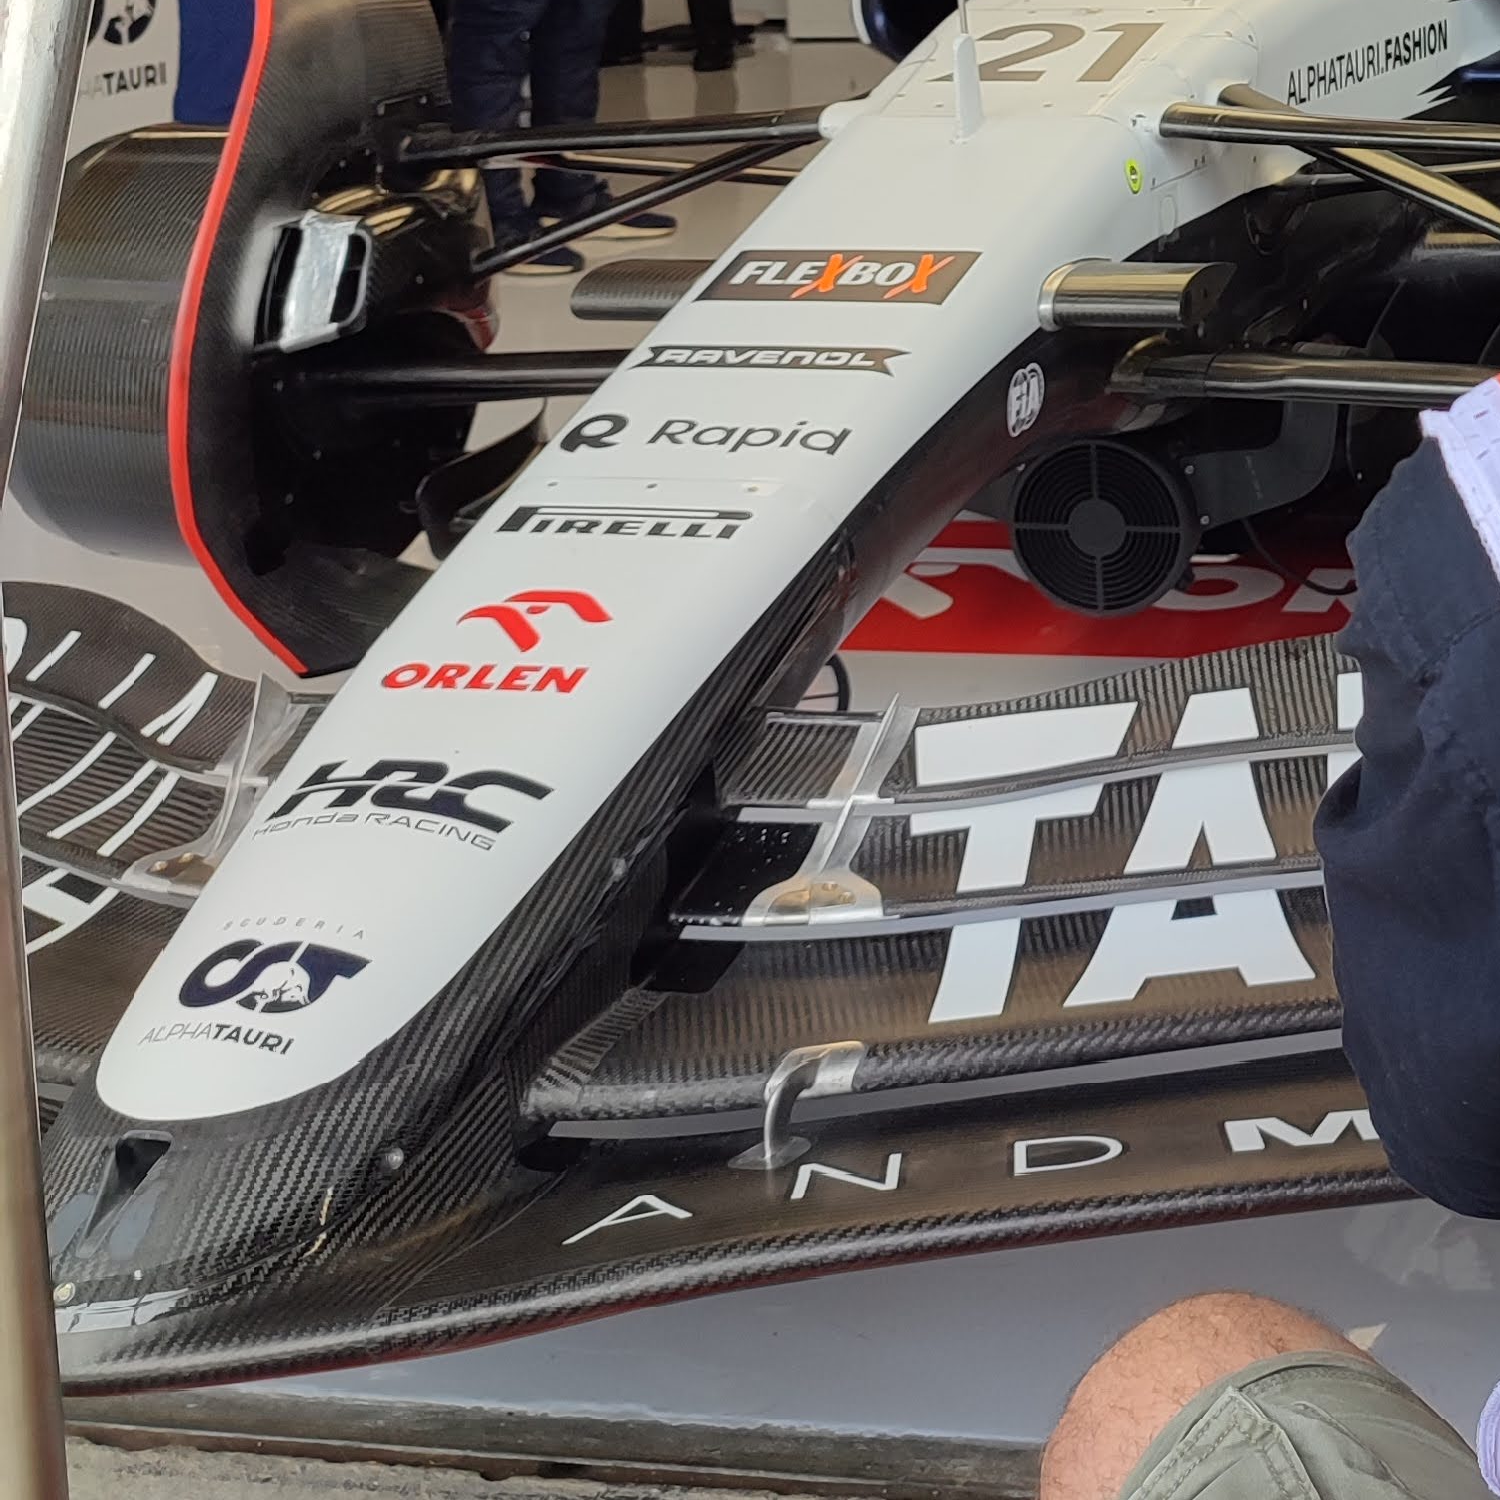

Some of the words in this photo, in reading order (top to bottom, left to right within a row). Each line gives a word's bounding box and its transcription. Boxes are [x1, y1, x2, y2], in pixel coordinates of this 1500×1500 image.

[1286, 19, 1449, 106] ALPHATAURI.FASHION
[729, 253, 955, 299] FLEXBOX
[651, 348, 878, 368] RAVENOL
[646, 419, 852, 456] Rapid
[496, 505, 753, 540] PIRELLI
[381, 661, 591, 693] ORLEN
[365, 812, 497, 851] RACING
[223, 916, 366, 941] SCUDERIA
[138, 1021, 295, 1056] ALPHATAURI
